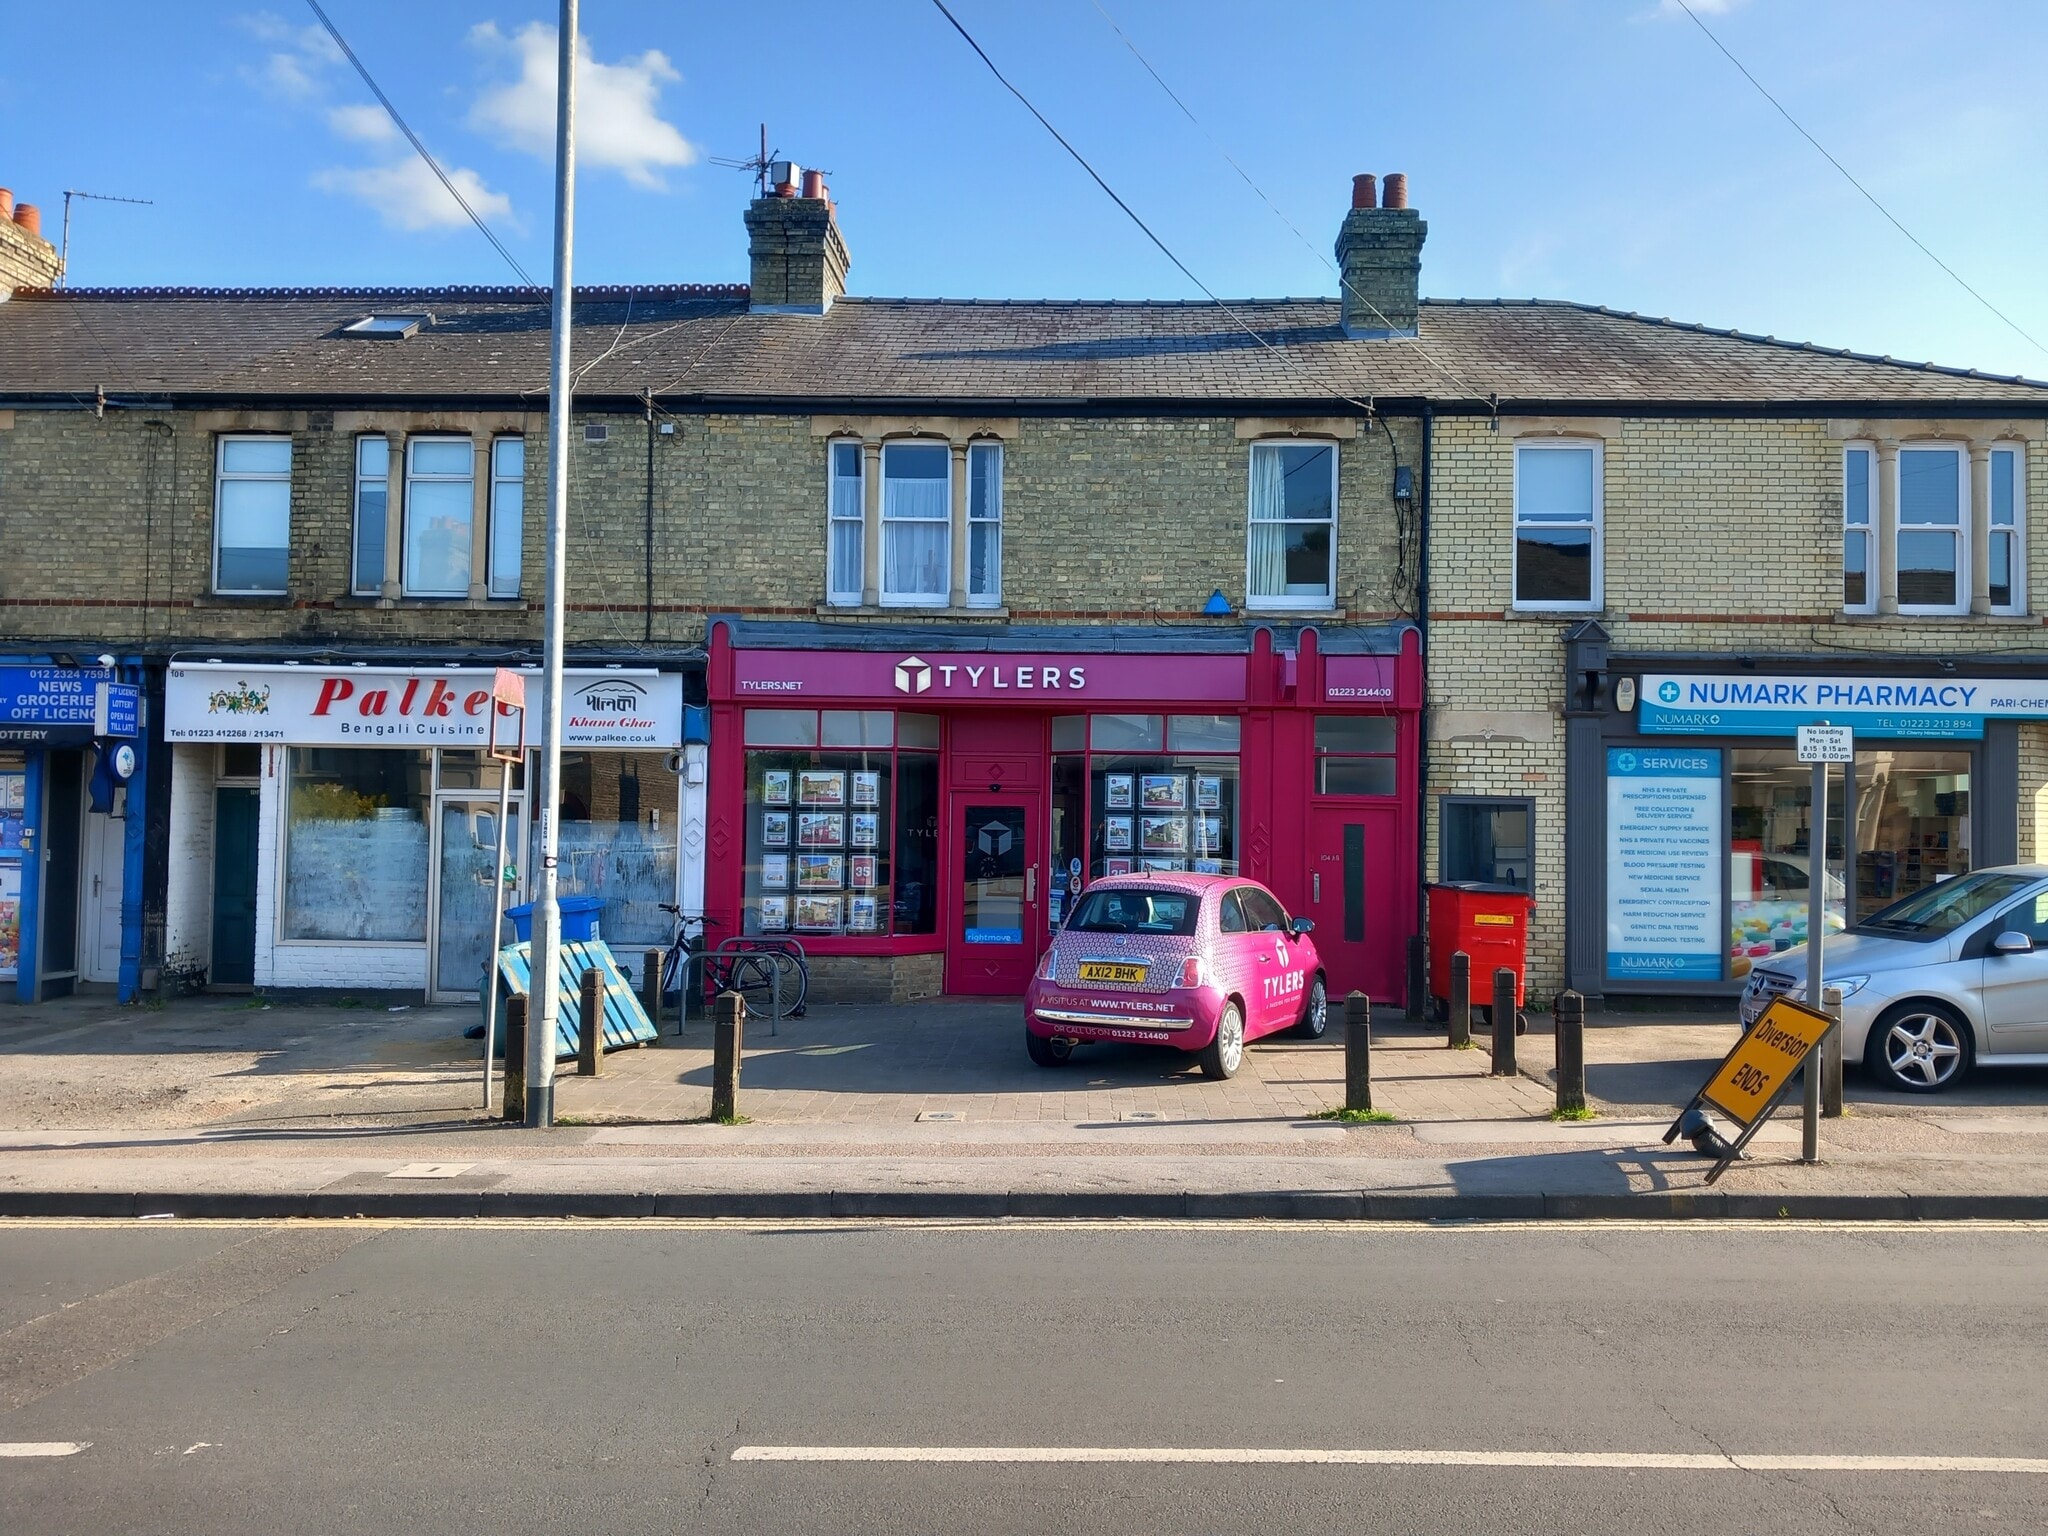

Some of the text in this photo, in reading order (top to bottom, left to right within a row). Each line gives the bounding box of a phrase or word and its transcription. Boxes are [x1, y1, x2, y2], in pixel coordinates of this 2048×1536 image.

[30, 670, 110, 679] 012 2324 7598
[938, 665, 1086, 688] TYLERS
[39, 682, 82, 692] NEWS
[741, 681, 803, 690] TYLERS.NET
[118, 688, 138, 697] LICENCE
[1328, 688, 1391, 696] 01223 214400
[1689, 682, 1978, 707] NUMARK PHARMACY
[17, 694, 95, 706] GROCERIE
[112, 700, 133, 709] LOTTERY
[11, 708, 39, 719] OFF
[1656, 713, 1709, 725] NUMARK
[122, 724, 134, 732] LATE
[569, 717, 656, 728] Khana Ghar
[1900, 720, 1930, 728] 01223
[1933, 720, 1950, 728] 213
[1953, 720, 1972, 728] 894
[0, 730, 48, 740] OTTERY
[170, 729, 186, 737] Tel:
[188, 729, 214, 737] 01223
[254, 730, 284, 738] 213471
[341, 723, 485, 736] Bengali Cuisine
[569, 734, 656, 742] www.palkee.co.uk
[1642, 758, 1708, 770] SERVICES
[855, 866, 871, 876] 35
[967, 934, 1011, 943] rightmove
[1621, 957, 1674, 968] NUMARK
[1086, 966, 1138, 980] AX12 BHK
[1264, 969, 1304, 999] TYLERS
[1047, 996, 1175, 1012] VISIT US AT WWW.TYLERS.NET
[1053, 1024, 1064, 1032] OR
[1066, 1025, 1084, 1034] CALL
[1098, 1028, 1110, 1036] ON
[1112, 1030, 1136, 1038] 01223
[1138, 1032, 1169, 1040] 214400
[1755, 1018, 1809, 1059] Diversion
[1730, 1063, 1770, 1096] ENDS
